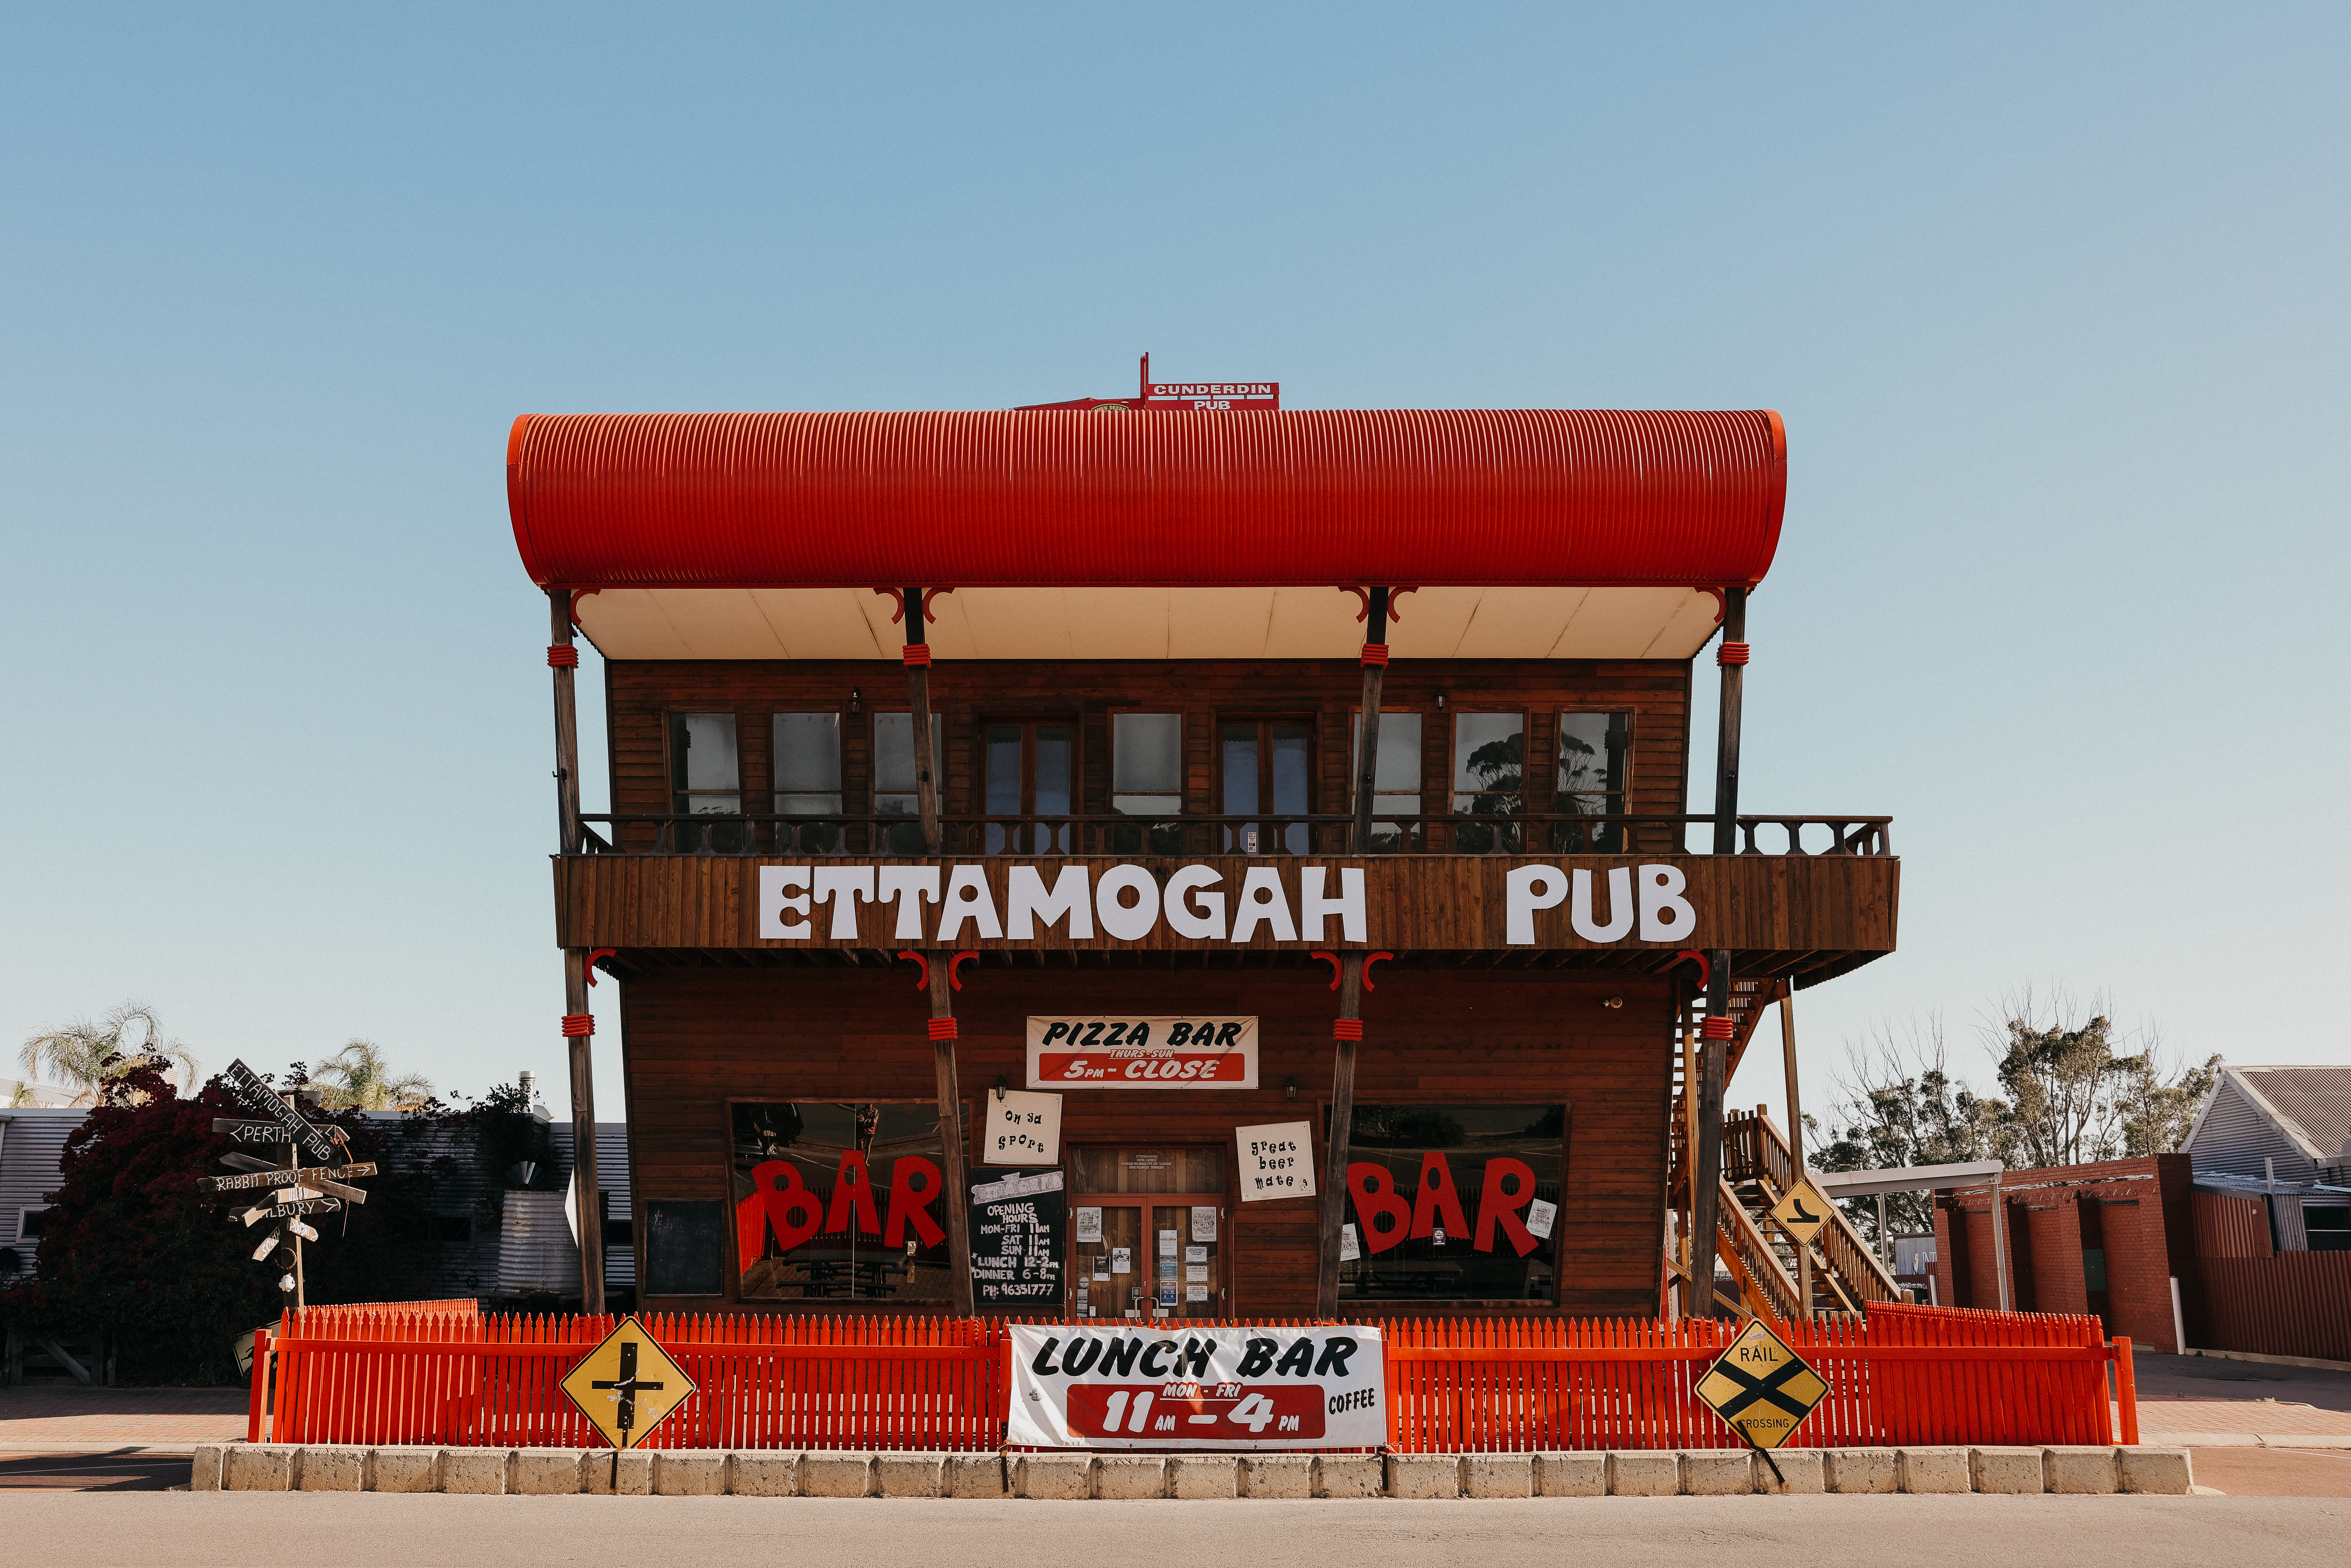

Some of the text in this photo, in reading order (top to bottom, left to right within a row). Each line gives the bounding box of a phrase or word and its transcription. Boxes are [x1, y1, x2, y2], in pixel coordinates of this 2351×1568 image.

[1154, 385, 1271, 395] CUNDERDIN
[1194, 401, 1231, 410] PUB
[759, 864, 1696, 944] ETTAMOGAH PUB
[1042, 1022, 1242, 1047] PIZZA BAR
[1110, 1049, 1175, 1058] THURS-SUN
[1125, 1060, 1220, 1079] CLOSE
[230, 1064, 331, 1160] ETTAMOGAH PUB
[1027, 1113, 1042, 1124] ya
[244, 1126, 291, 1143] PERTH
[1251, 1141, 1296, 1156] great
[1259, 1156, 1294, 1170] beer
[216, 1174, 259, 1191] RABBIT
[265, 1170, 304, 1186] PROOF
[1255, 1175, 1293, 1190] mate
[751, 1150, 947, 1251] BAR
[1346, 1152, 1540, 1258] BAR
[987, 1203, 1034, 1216] OPENING
[1003, 1213, 1038, 1223] HOURS
[981, 1224, 1020, 1234] MON-FRI
[262, 1228, 281, 1257] SOUTH
[1001, 1235, 1022, 1245] SAT
[1001, 1245, 1022, 1255] SUN
[1001, 1282, 1054, 1296] 96351777
[1032, 1337, 1358, 1378] LUNCH BAR
[1740, 1347, 1778, 1362] RAIL
[1163, 1384, 1197, 1397] MON
[1215, 1384, 1240, 1397] FRI
[1329, 1388, 1375, 1414] COFFEE
